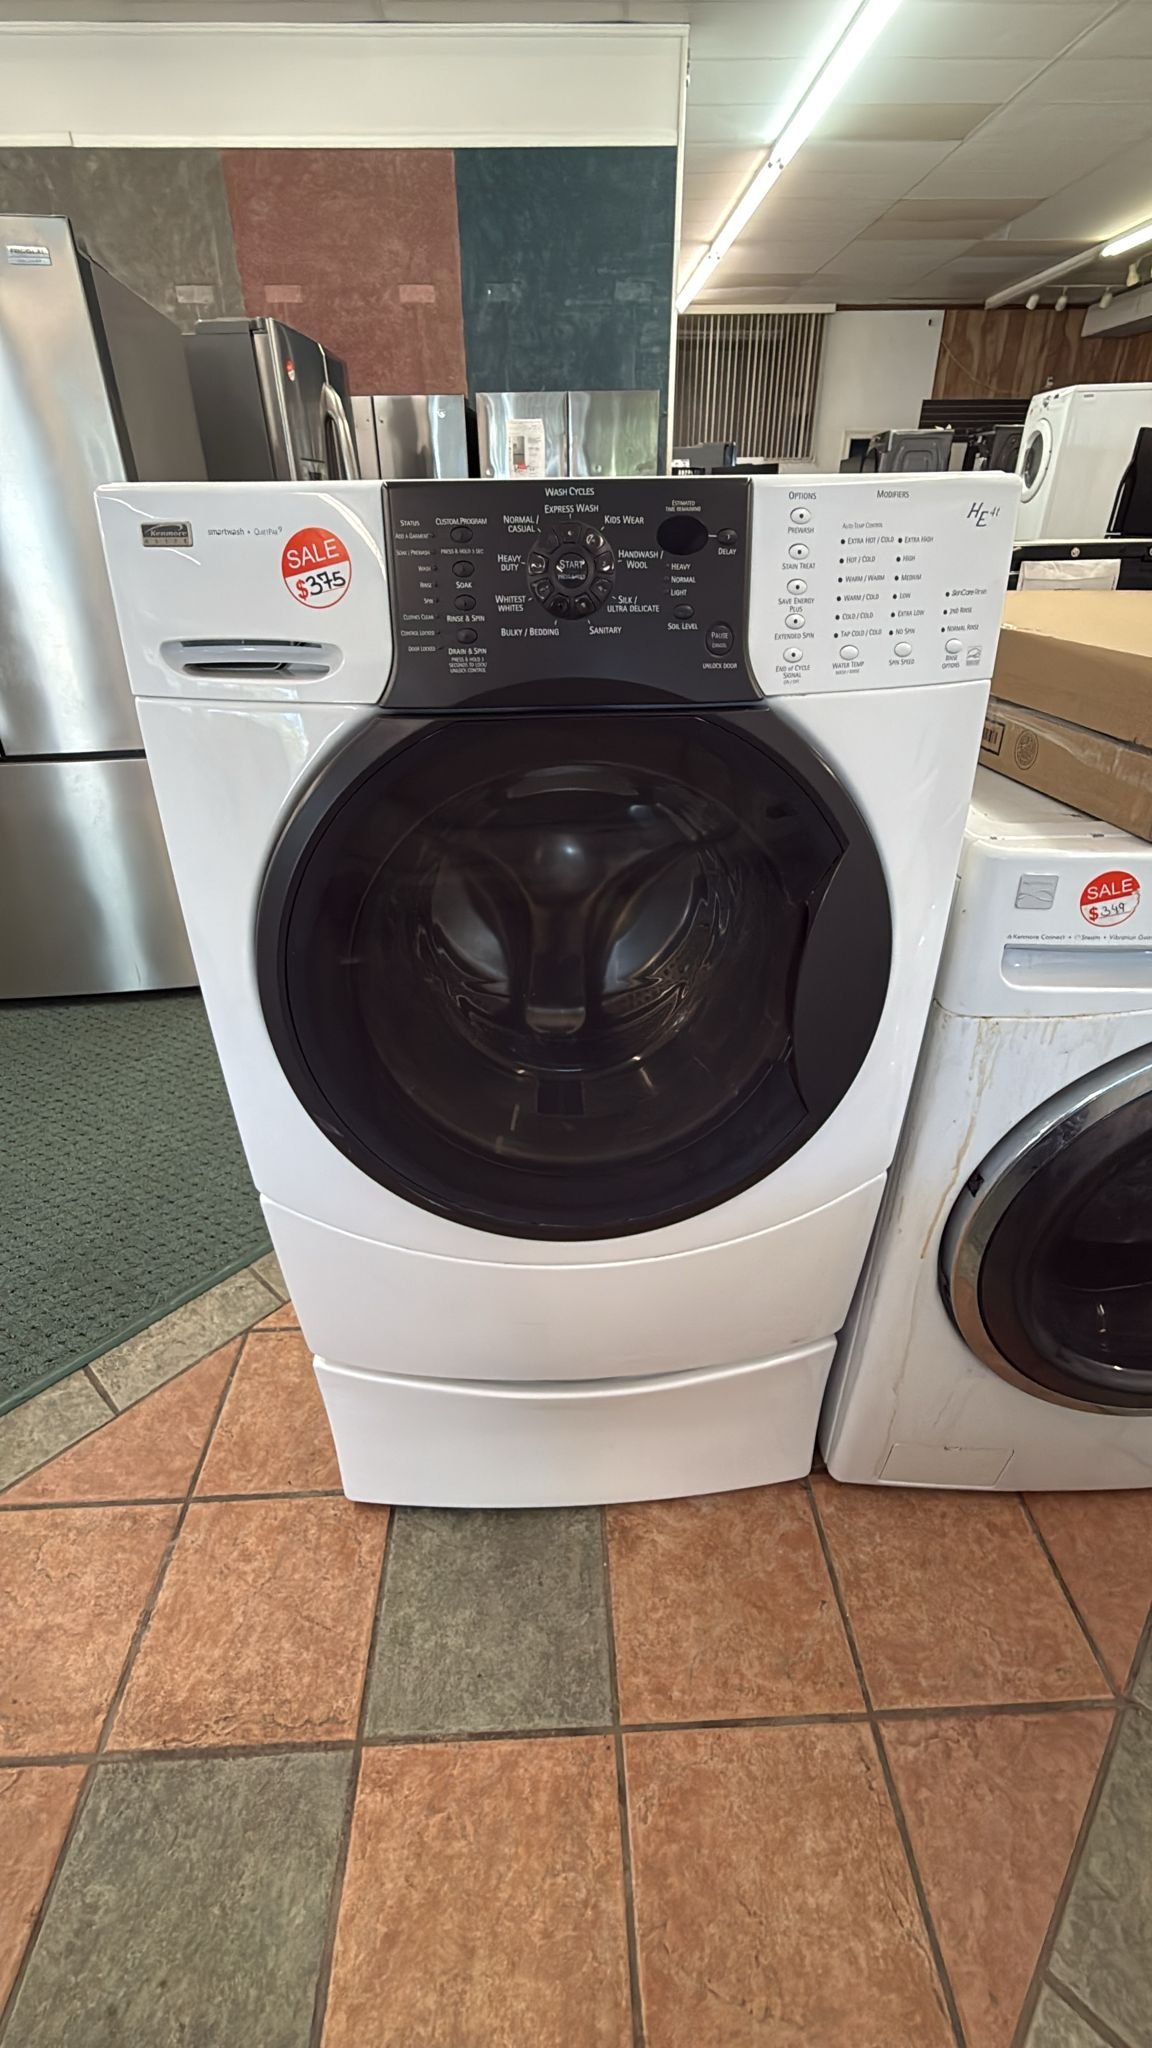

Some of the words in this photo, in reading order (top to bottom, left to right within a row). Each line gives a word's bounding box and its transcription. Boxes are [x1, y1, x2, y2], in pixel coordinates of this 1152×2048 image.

[545, 487, 568, 497] WASH
[569, 486, 595, 496] CYCLES
[788, 490, 817, 500] OPTIONS
[876, 489, 910, 499] MODIFIERS
[544, 504, 574, 514] EXPRESS
[576, 503, 599, 513] WASH
[400, 519, 420, 527] STATUS
[459, 517, 488, 525] PROGRAM
[503, 514, 535, 524] NORMAL
[604, 514, 621, 524] KIDS
[622, 515, 645, 525] WEAR
[207, 527, 245, 536] smartwash
[507, 524, 536, 533] CASUAL
[787, 526, 815, 534] PREWASH
[150, 529, 187, 538] Kenmore
[847, 537, 864, 545] EXTRA
[865, 536, 877, 544] HOT
[880, 535, 894, 544] COLD
[904, 536, 920, 544] EXTRA
[286, 538, 340, 569] SALE
[618, 549, 659, 559] HANDWASH
[717, 547, 737, 556] DELAY
[497, 554, 522, 563] HEAVY
[861, 555, 876, 563] COLD
[500, 563, 519, 572] DUTY
[559, 559, 584, 570] START
[626, 560, 648, 569] WOOL
[671, 563, 691, 571] HEAVY
[845, 575, 863, 583] WARM
[867, 574, 885, 582] WARM
[295, 570, 347, 601] $375
[455, 581, 473, 589] SOAK
[670, 589, 688, 597] LIGHT
[865, 593, 880, 601] COLD
[495, 594, 526, 604] WHITEST
[618, 595, 633, 604] SILK
[778, 597, 792, 605] SAVE
[793, 597, 815, 605] ENERGY
[497, 604, 524, 612] WHITES
[607, 604, 628, 613] ULTRA
[629, 604, 660, 613] DELICATE
[471, 614, 485, 622] SPIN
[859, 611, 874, 619] COLD
[589, 625, 622, 635] SANITARY
[667, 622, 681, 630] SOIL
[681, 622, 698, 630] LEVEL
[500, 627, 523, 637] BULKY
[529, 627, 560, 636] BEDDING
[711, 631, 729, 640] PAUSE
[774, 632, 802, 641] EXTENDED
[775, 665, 787, 673] END
[794, 664, 811, 672] CYCLE
[1087, 878, 1133, 900] SALE
[1088, 902, 1126, 922] $349
